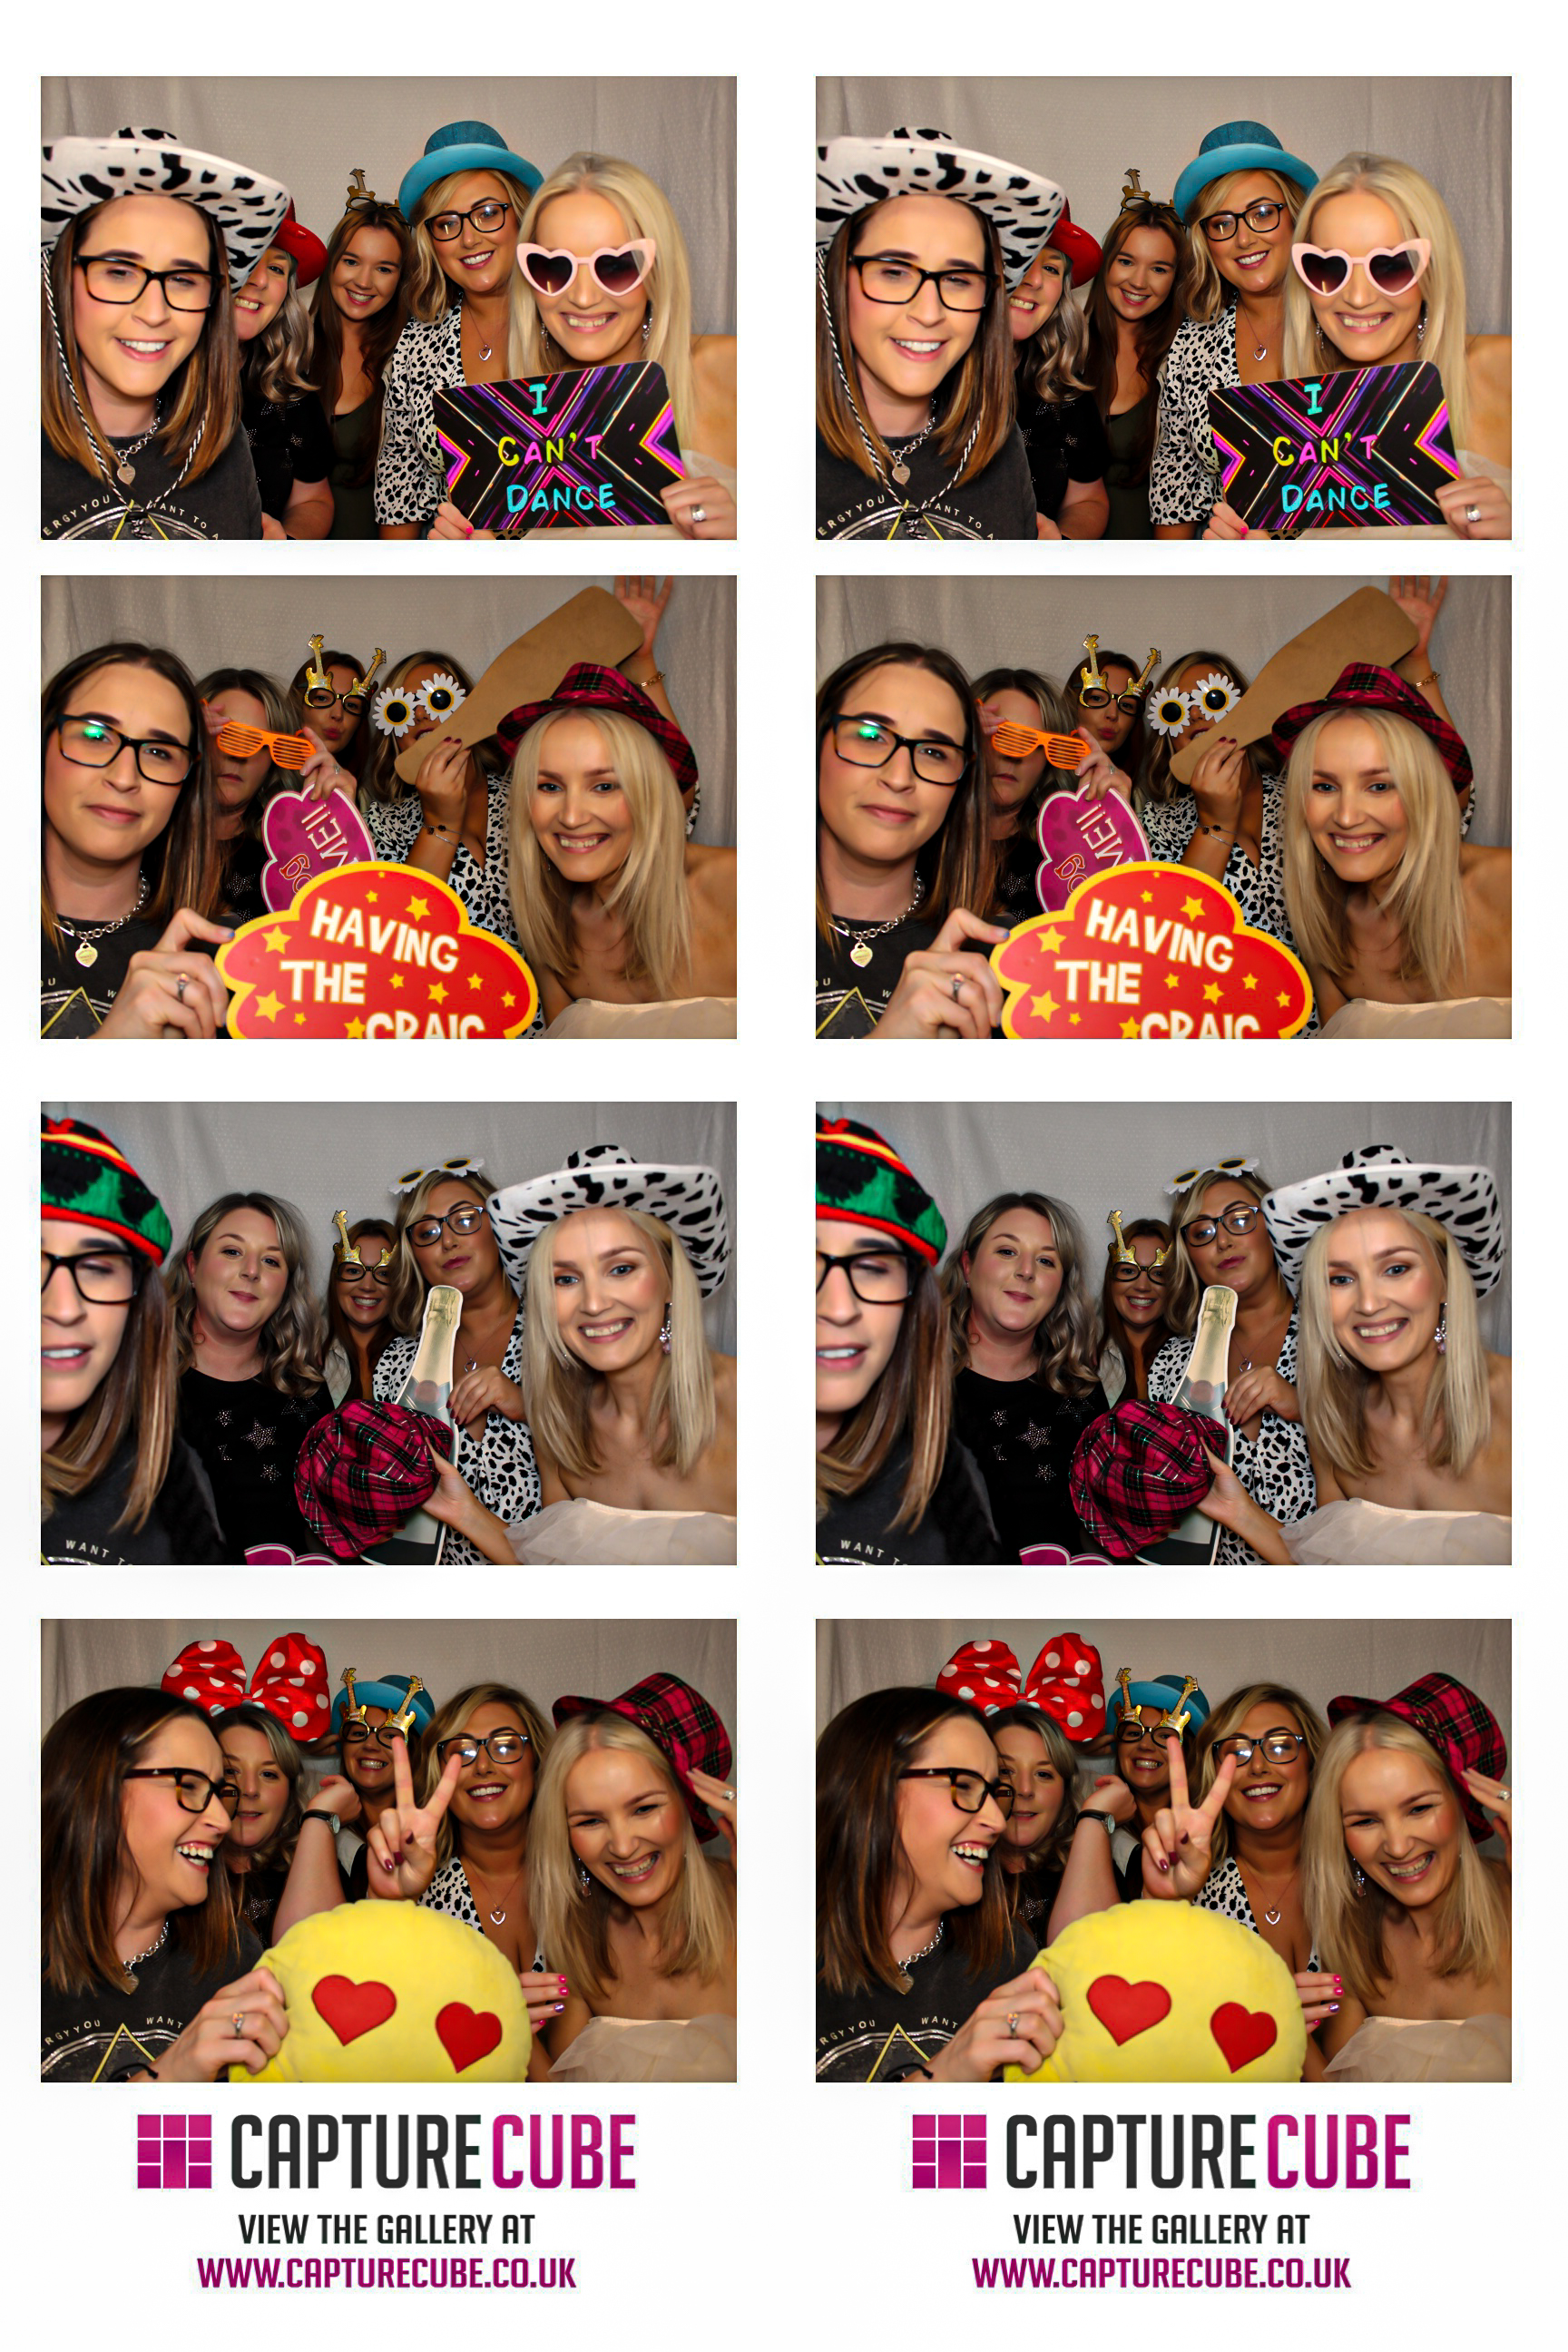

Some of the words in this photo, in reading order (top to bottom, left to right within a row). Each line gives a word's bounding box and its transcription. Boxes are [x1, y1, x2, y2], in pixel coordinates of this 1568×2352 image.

[529, 383, 548, 415] I
[1304, 383, 1323, 415] I
[498, 432, 603, 466] CAN'T
[1273, 432, 1378, 466] CAN'T
[506, 483, 616, 513] DANCE
[1281, 483, 1391, 513] DANCE
[193, 515, 207, 529] TO
[968, 515, 982, 529] TO
[310, 898, 459, 973] HAVING
[1085, 898, 1234, 973] HAVING
[279, 960, 368, 1004] THE
[1054, 960, 1142, 1004] THE
[366, 1010, 485, 1039] CRAIC
[1141, 1010, 1260, 1039] CRAIC
[66, 1540, 110, 1558] WANT
[841, 1540, 885, 1558] WANT
[146, 2015, 183, 2029] WANT
[921, 2015, 958, 2029] WANT
